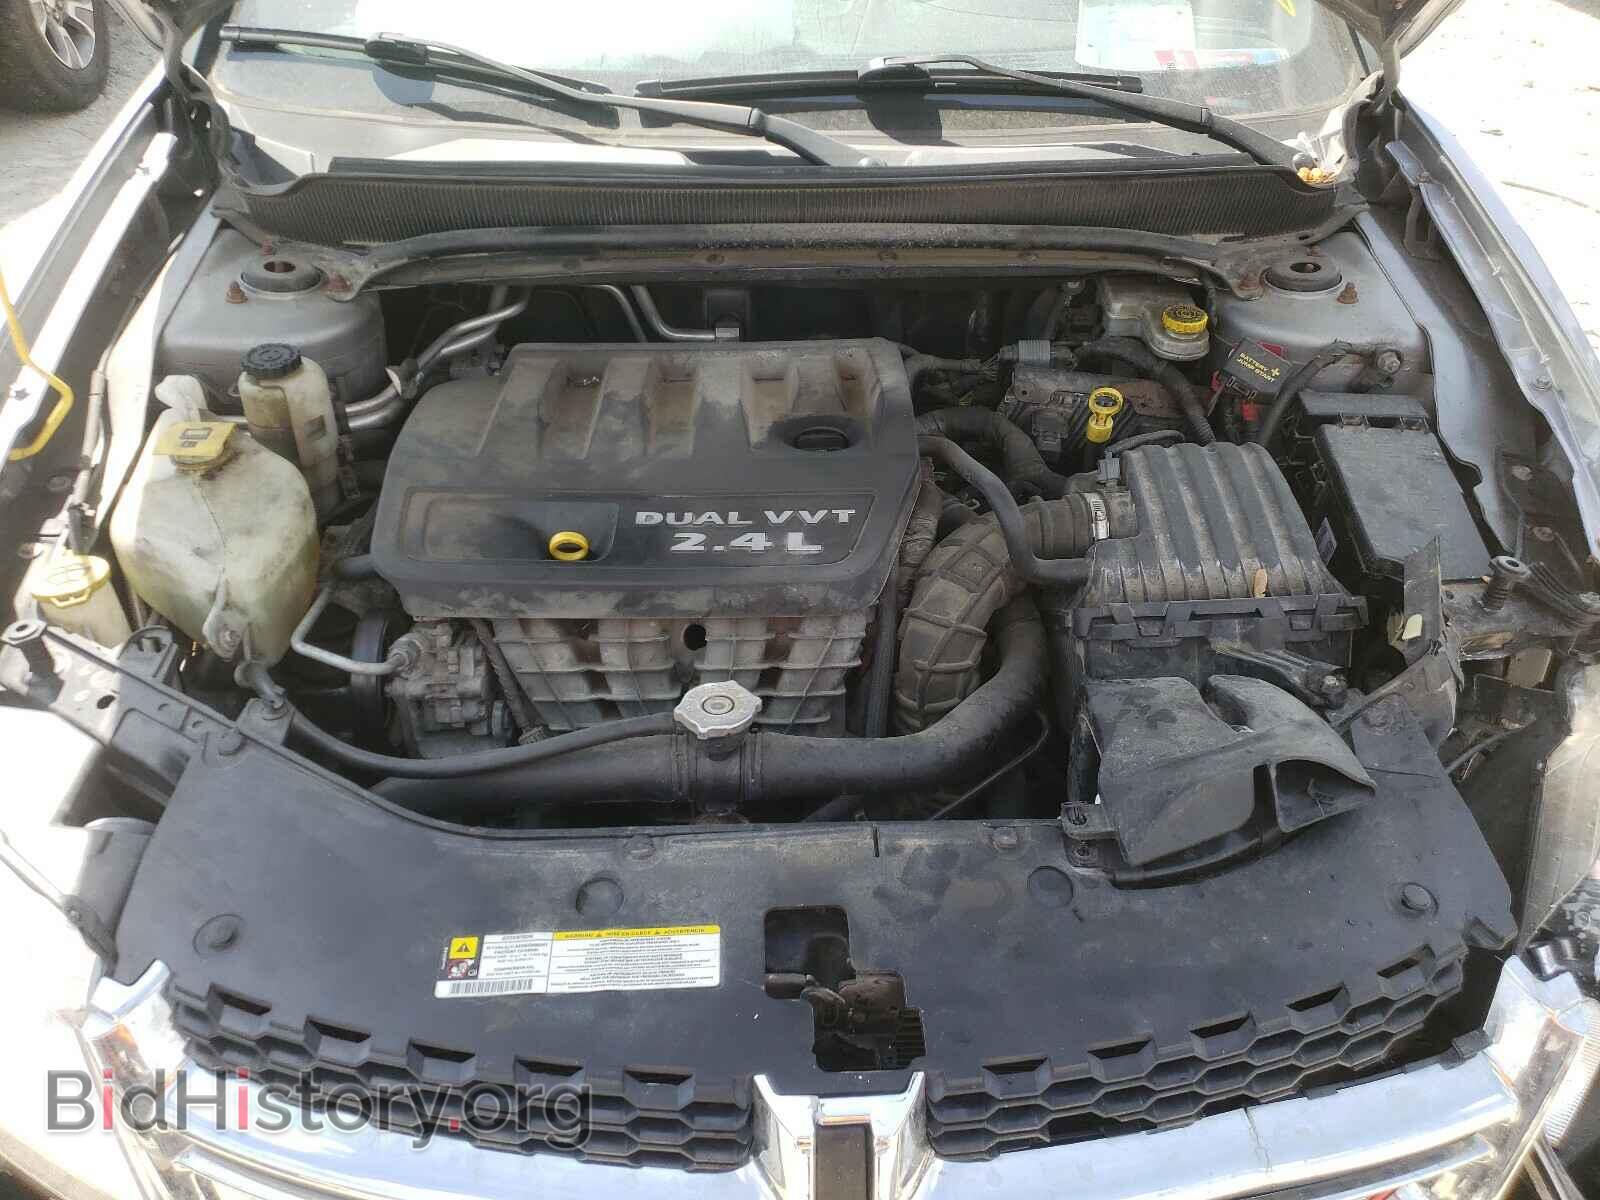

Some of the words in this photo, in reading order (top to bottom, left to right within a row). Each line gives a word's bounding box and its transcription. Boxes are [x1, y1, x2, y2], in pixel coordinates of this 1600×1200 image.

[1237, 359, 1255, 370] JUMP
[1255, 368, 1275, 383] START
[1240, 352, 1269, 372] BATTERY
[635, 511, 753, 526] DUAL
[763, 508, 857, 525] VVT
